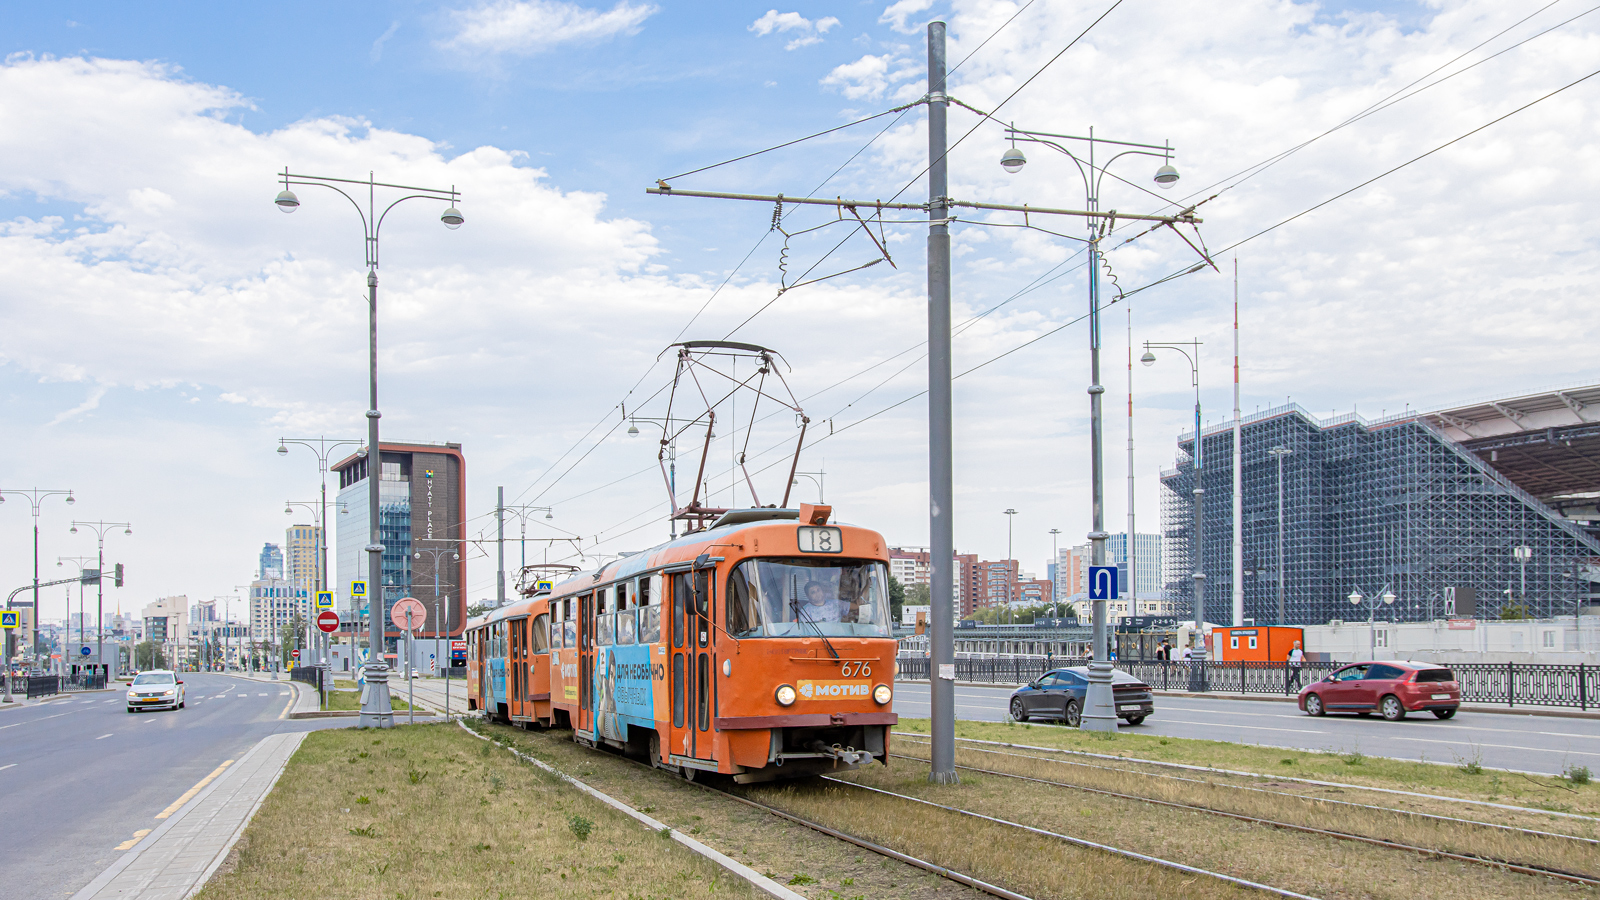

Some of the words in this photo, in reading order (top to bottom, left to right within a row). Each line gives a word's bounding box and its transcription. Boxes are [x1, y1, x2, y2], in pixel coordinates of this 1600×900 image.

[810, 529, 832, 551] 18
[1125, 617, 1132, 626] 5
[617, 663, 629, 683] ДЛЯ
[629, 663, 665, 681] НЕОБЫЧНО
[841, 661, 872, 678] 676
[815, 684, 870, 697] МОТИВ
